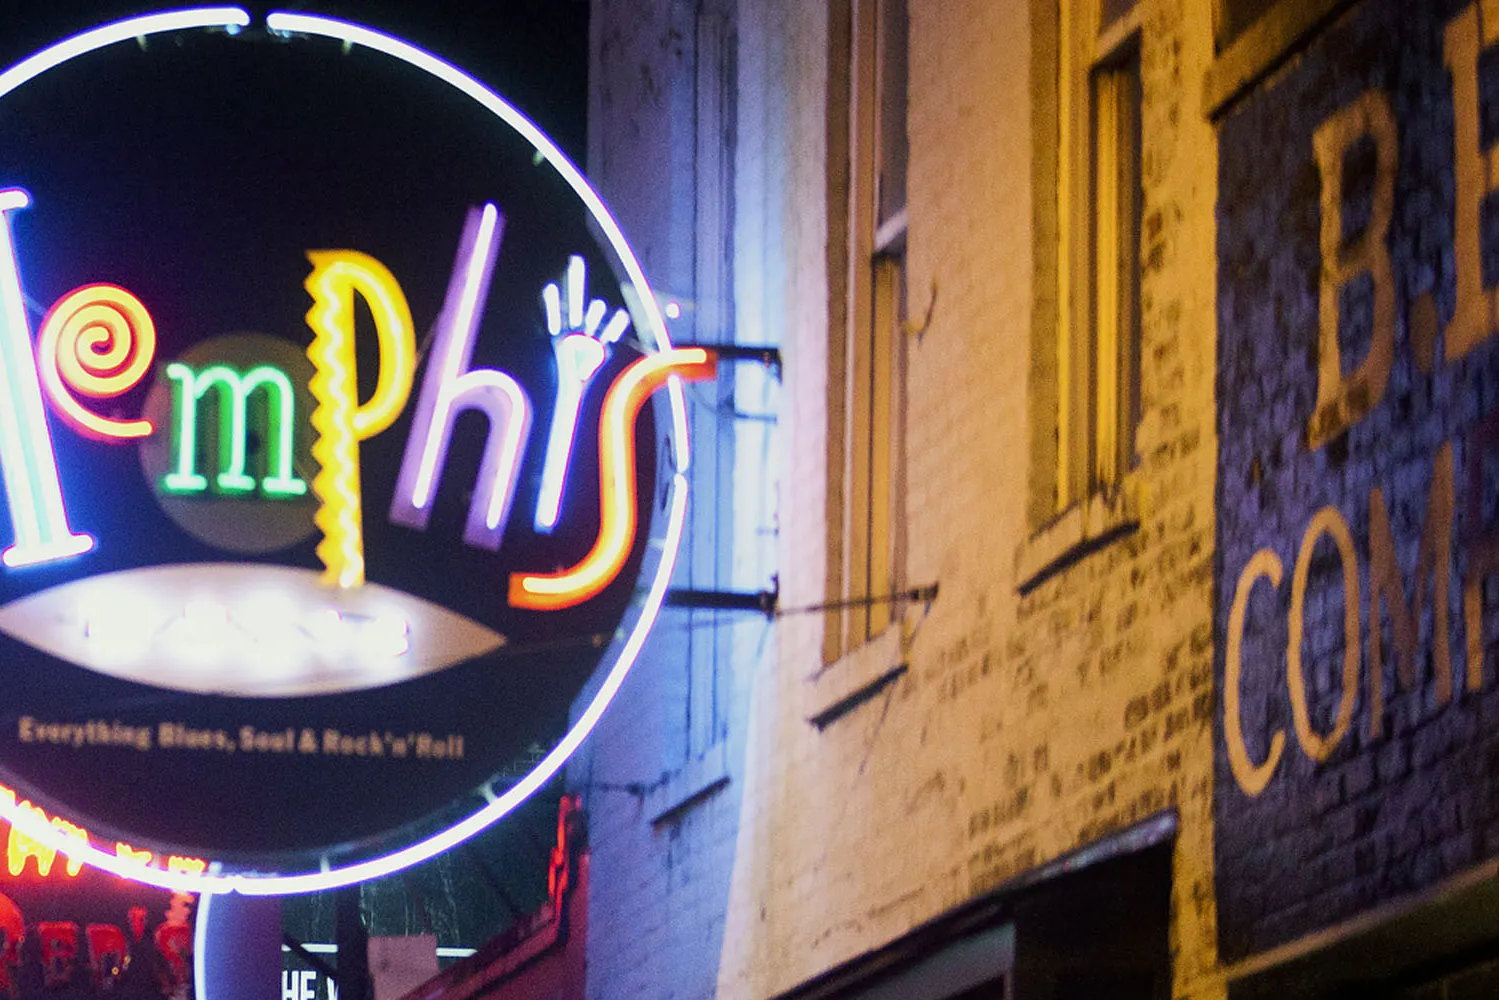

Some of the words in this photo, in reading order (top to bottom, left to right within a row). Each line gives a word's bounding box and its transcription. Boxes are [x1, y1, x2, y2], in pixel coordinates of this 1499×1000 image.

[1223, 441, 1496, 797] COM
[19, 716, 151, 750] Everything
[158, 722, 236, 753] Blues,
[239, 726, 294, 753] Soul
[298, 729, 316, 754] &
